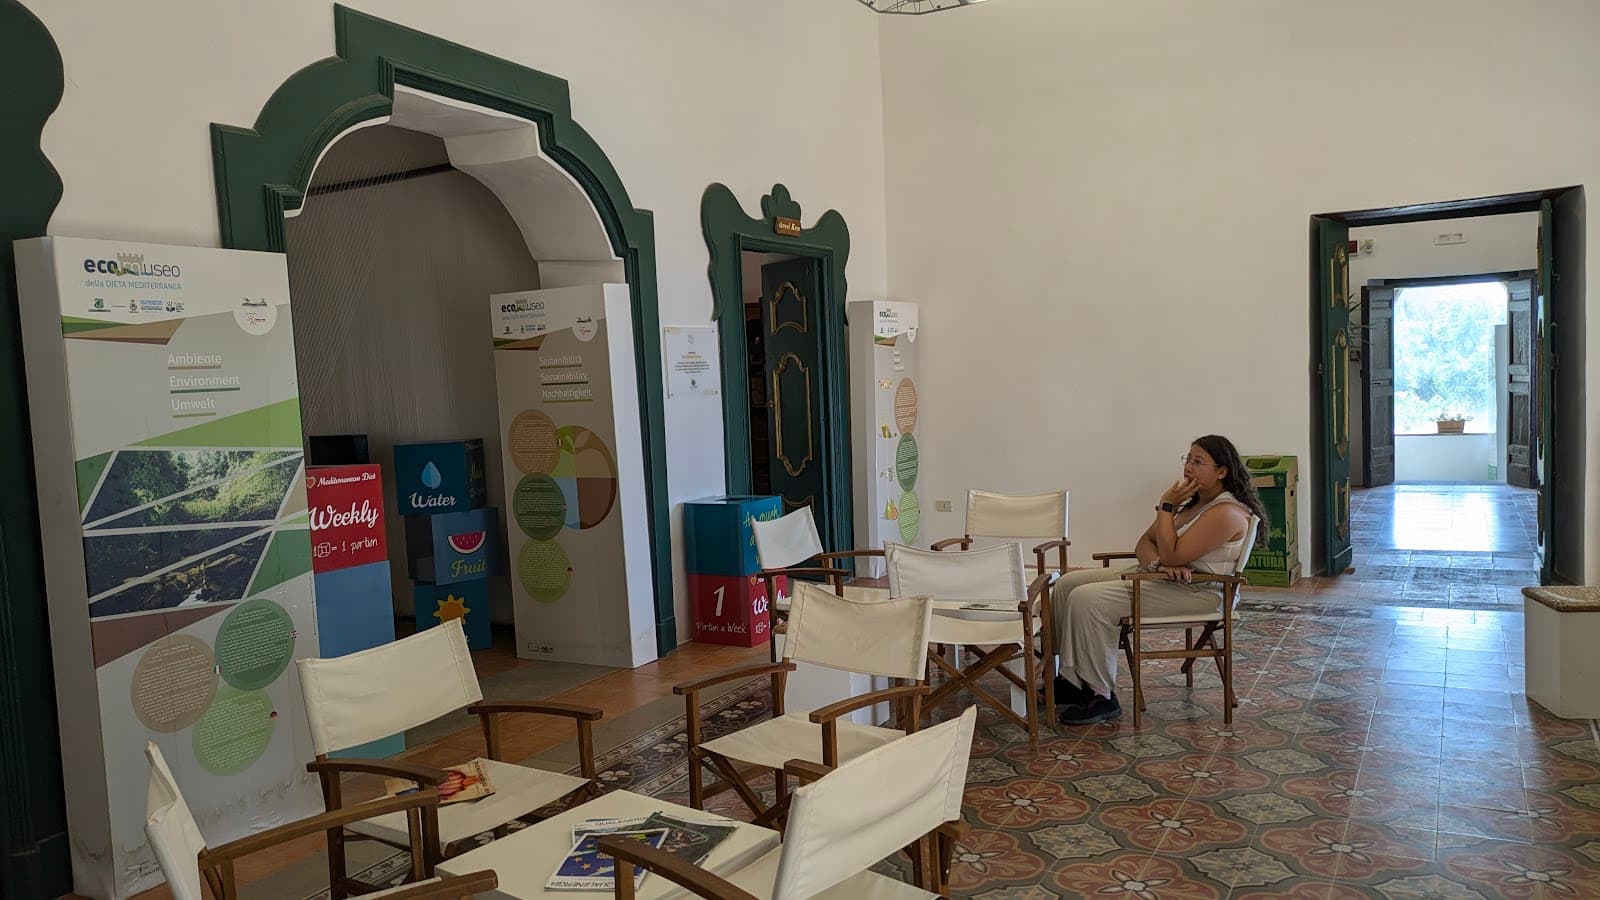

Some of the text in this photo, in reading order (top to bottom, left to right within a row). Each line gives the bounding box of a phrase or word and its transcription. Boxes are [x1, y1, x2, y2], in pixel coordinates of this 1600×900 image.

[85, 278, 182, 290] della DIETA MEDITERRANEA
[168, 352, 222, 364] Ambiente
[170, 375, 240, 388] Environment
[171, 397, 216, 410] Umwelt
[317, 472, 376, 487] Mediterranean Diet
[408, 491, 457, 508] Water
[309, 499, 379, 531] Weekly
[342, 540, 346, 552] 1
[350, 537, 378, 555] portion
[451, 559, 488, 578] Fruit
[713, 585, 725, 617] 1
[696, 621, 719, 633] Portion
[727, 622, 748, 634] Week
